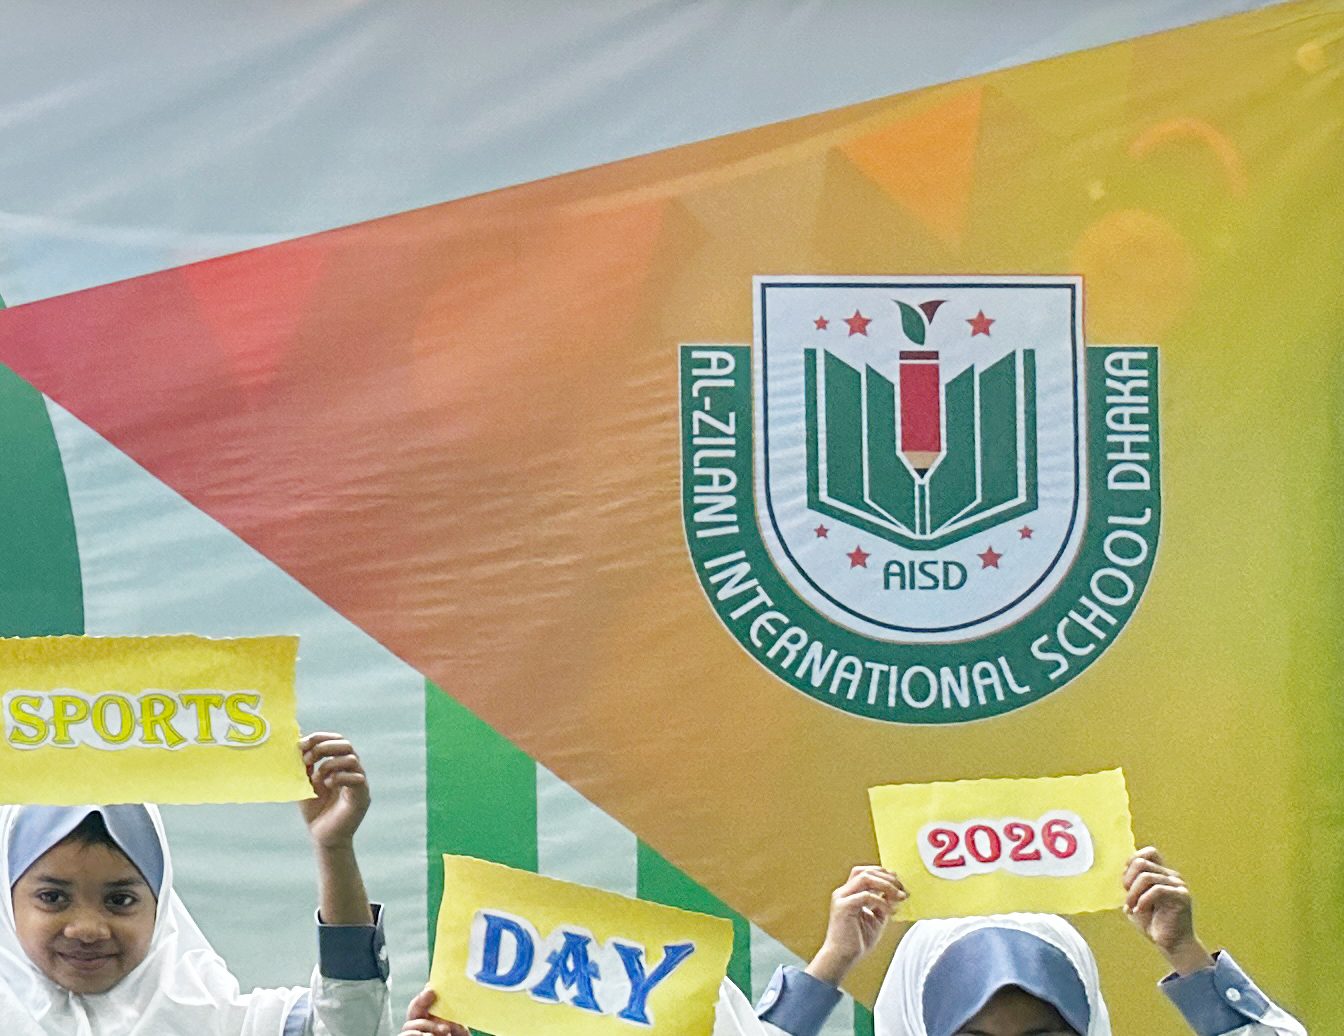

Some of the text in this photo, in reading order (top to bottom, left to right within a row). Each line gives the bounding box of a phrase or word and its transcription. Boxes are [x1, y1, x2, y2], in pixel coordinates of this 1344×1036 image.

[690, 349, 1152, 710] AL-ZILANI INTERNATIONAL SCHOOL DHAKA
[882, 560, 969, 591] AISD
[7, 693, 268, 748] SPORTS
[927, 818, 1079, 868] 2026
[473, 913, 696, 1027] DAY
